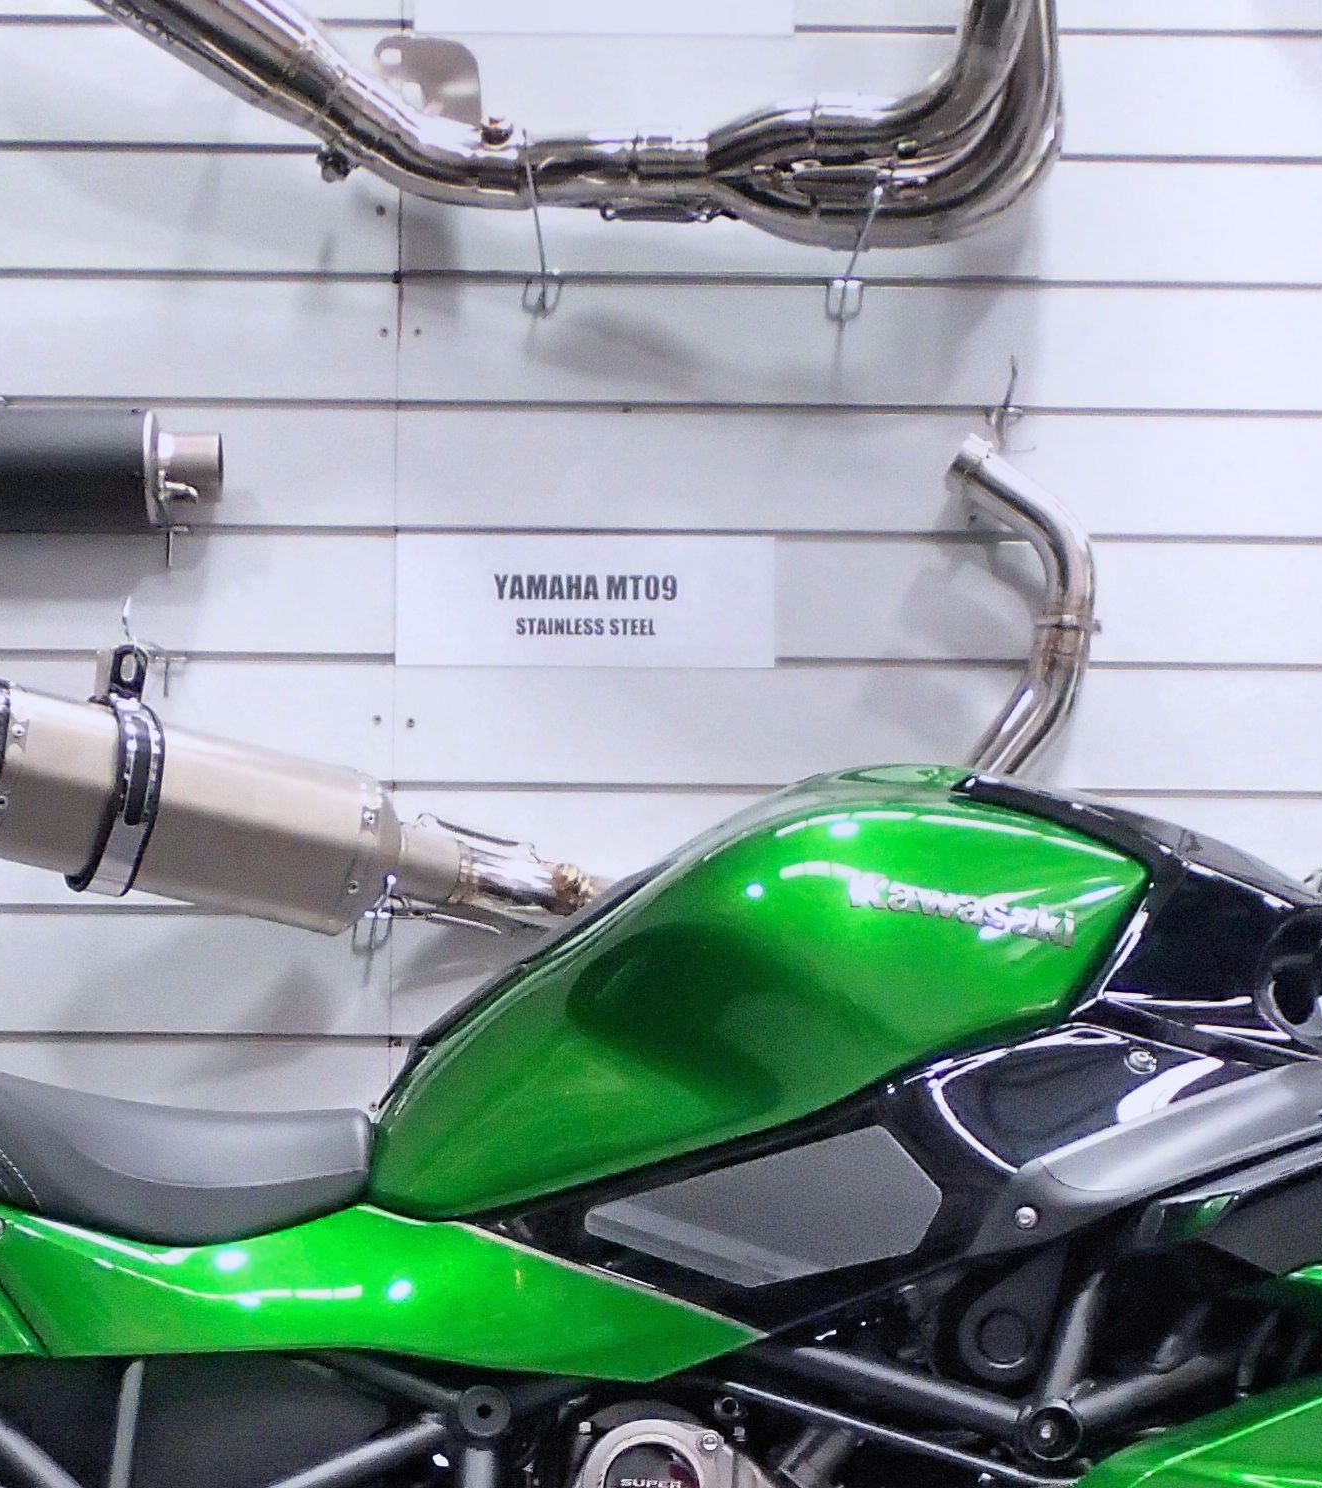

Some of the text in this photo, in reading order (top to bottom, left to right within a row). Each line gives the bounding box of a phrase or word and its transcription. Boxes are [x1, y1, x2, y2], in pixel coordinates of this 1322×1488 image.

[494, 574, 678, 601] YAMAHA MT09
[516, 617, 656, 636] STAINLESS STEEL
[849, 871, 1075, 948] Kawasaki
[620, 1478, 682, 1488] SUPER
